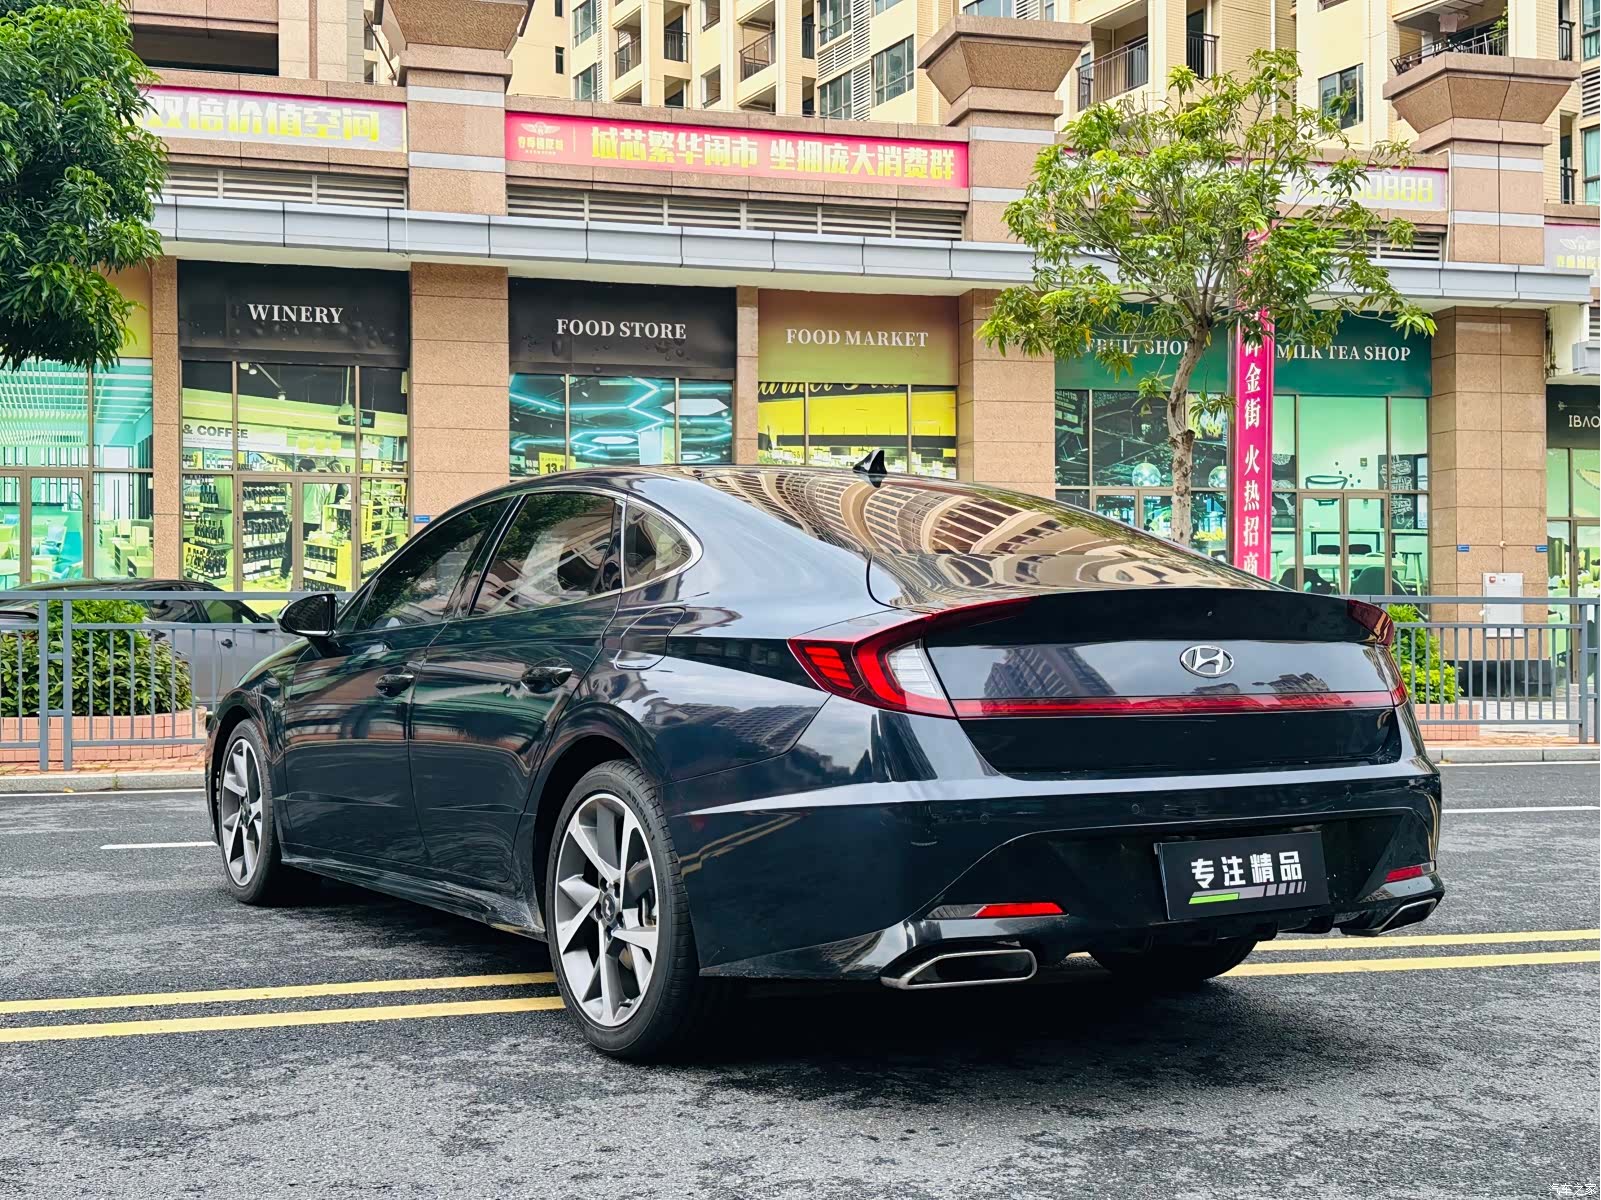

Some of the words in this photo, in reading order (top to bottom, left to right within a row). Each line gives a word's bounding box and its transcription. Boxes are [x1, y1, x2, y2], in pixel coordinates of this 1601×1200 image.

[147, 95, 380, 142] 双倍价值空间
[591, 126, 758, 168] 城芯繁华闹市
[769, 139, 955, 180] 坐拥庞大消费群
[247, 304, 343, 323] WINERY
[556, 319, 615, 336] FOOD
[619, 321, 686, 339] STORE
[786, 328, 840, 344] FOOD
[845, 330, 928, 347] MARKET
[1145, 340, 1189, 355] SHO
[1276, 344, 1322, 359] MILK
[1328, 345, 1360, 360] TEA
[1364, 346, 1411, 361] SHOP
[1191, 851, 1303, 889] 专注精品
